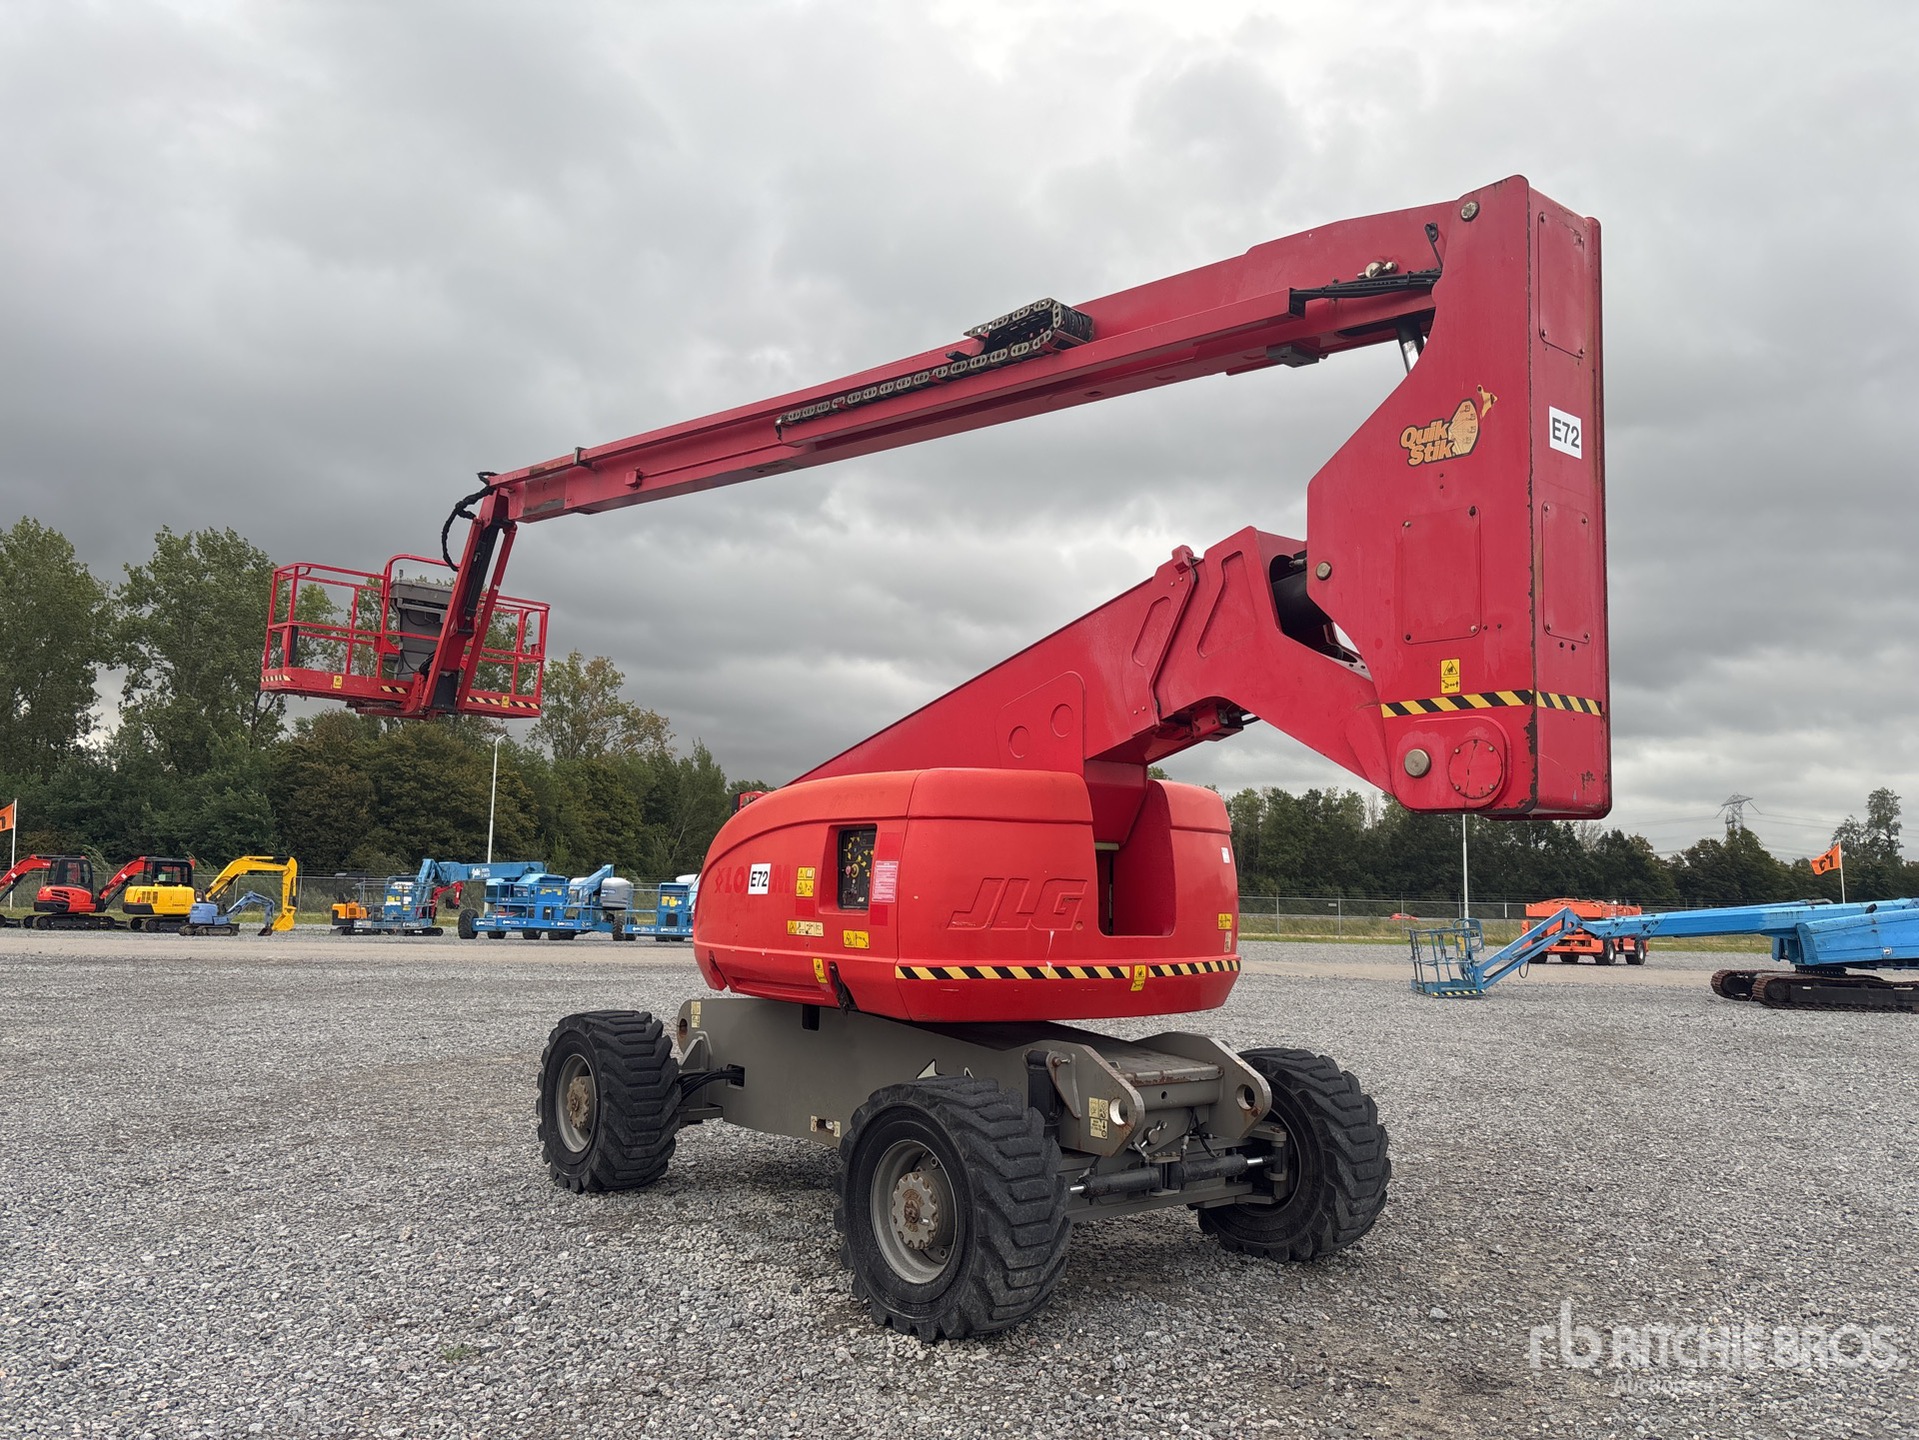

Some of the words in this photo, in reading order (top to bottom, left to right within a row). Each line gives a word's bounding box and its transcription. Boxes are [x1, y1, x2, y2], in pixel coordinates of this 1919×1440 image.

[1400, 419, 1450, 449] Quik
[1552, 416, 1580, 449] E72
[1408, 439, 1454, 466] Stik
[722, 865, 790, 893] LOM
[750, 870, 769, 888] E72
[947, 877, 1088, 931] JLG
